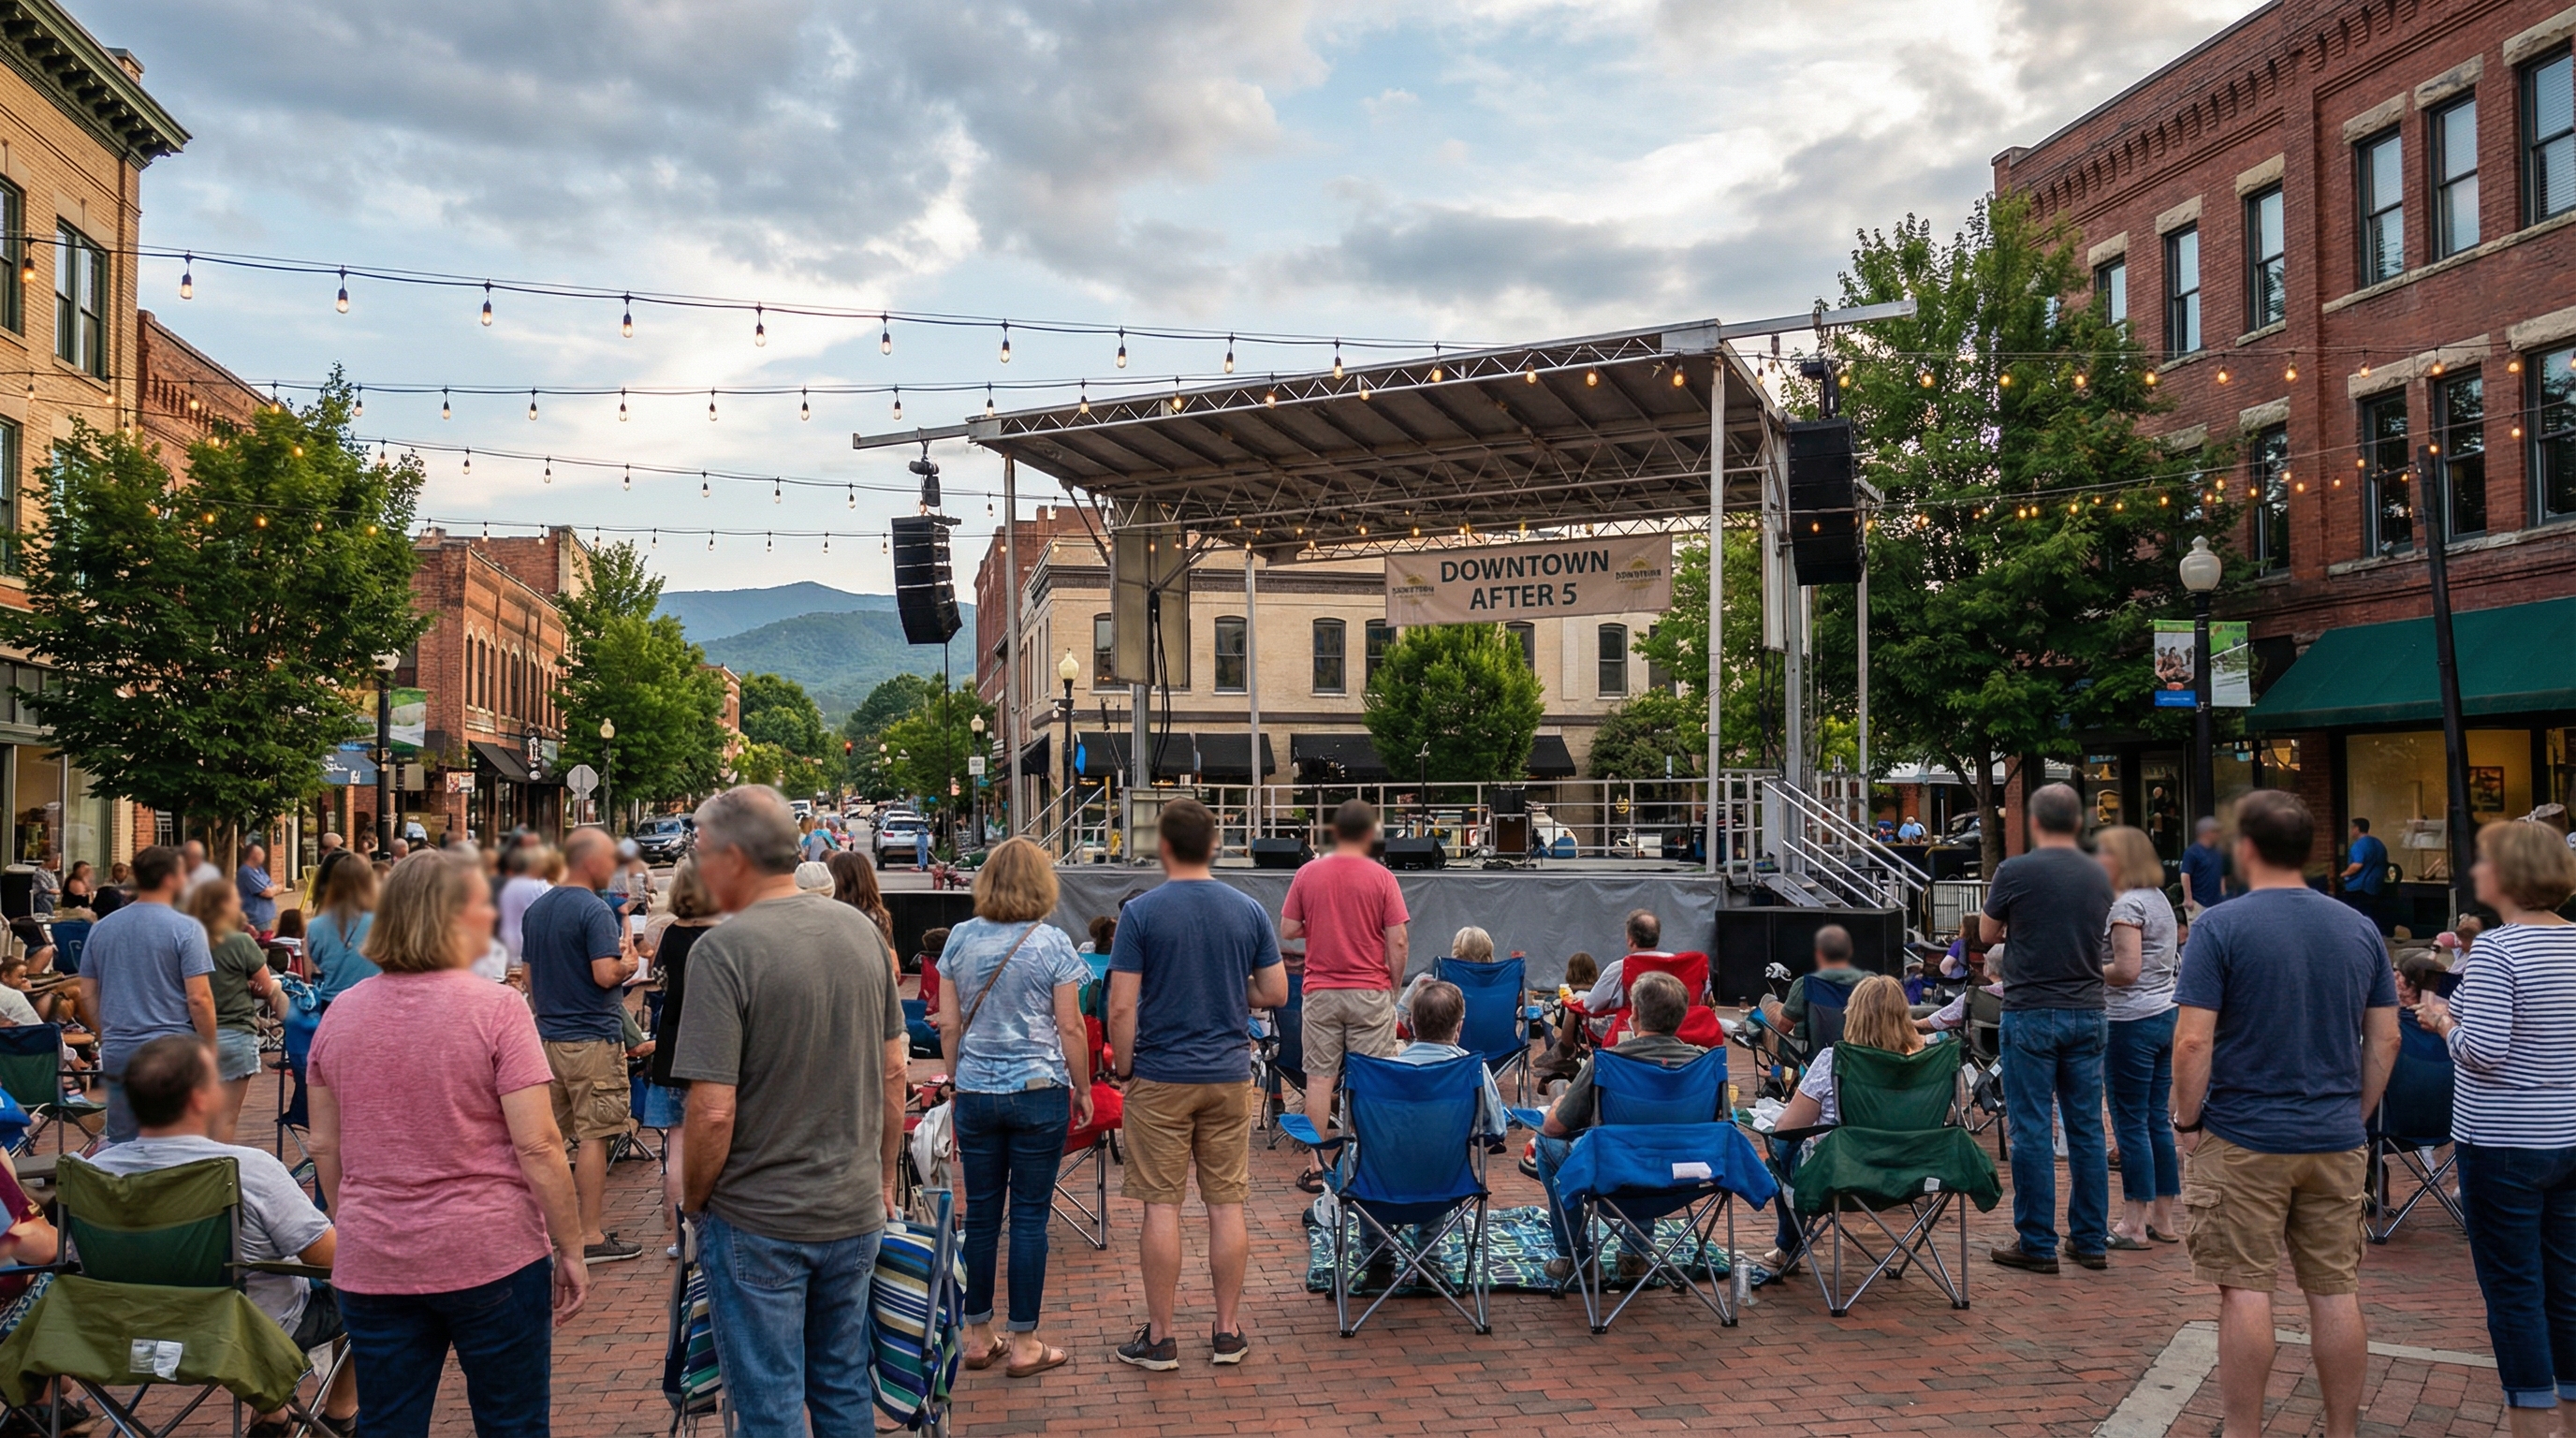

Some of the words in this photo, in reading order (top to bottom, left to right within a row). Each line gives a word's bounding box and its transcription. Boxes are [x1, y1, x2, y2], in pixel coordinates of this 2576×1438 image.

[1441, 550, 1609, 583] DOWNTOWN
[1469, 583, 1555, 610] AFTER
[1561, 581, 1577, 606] 5
